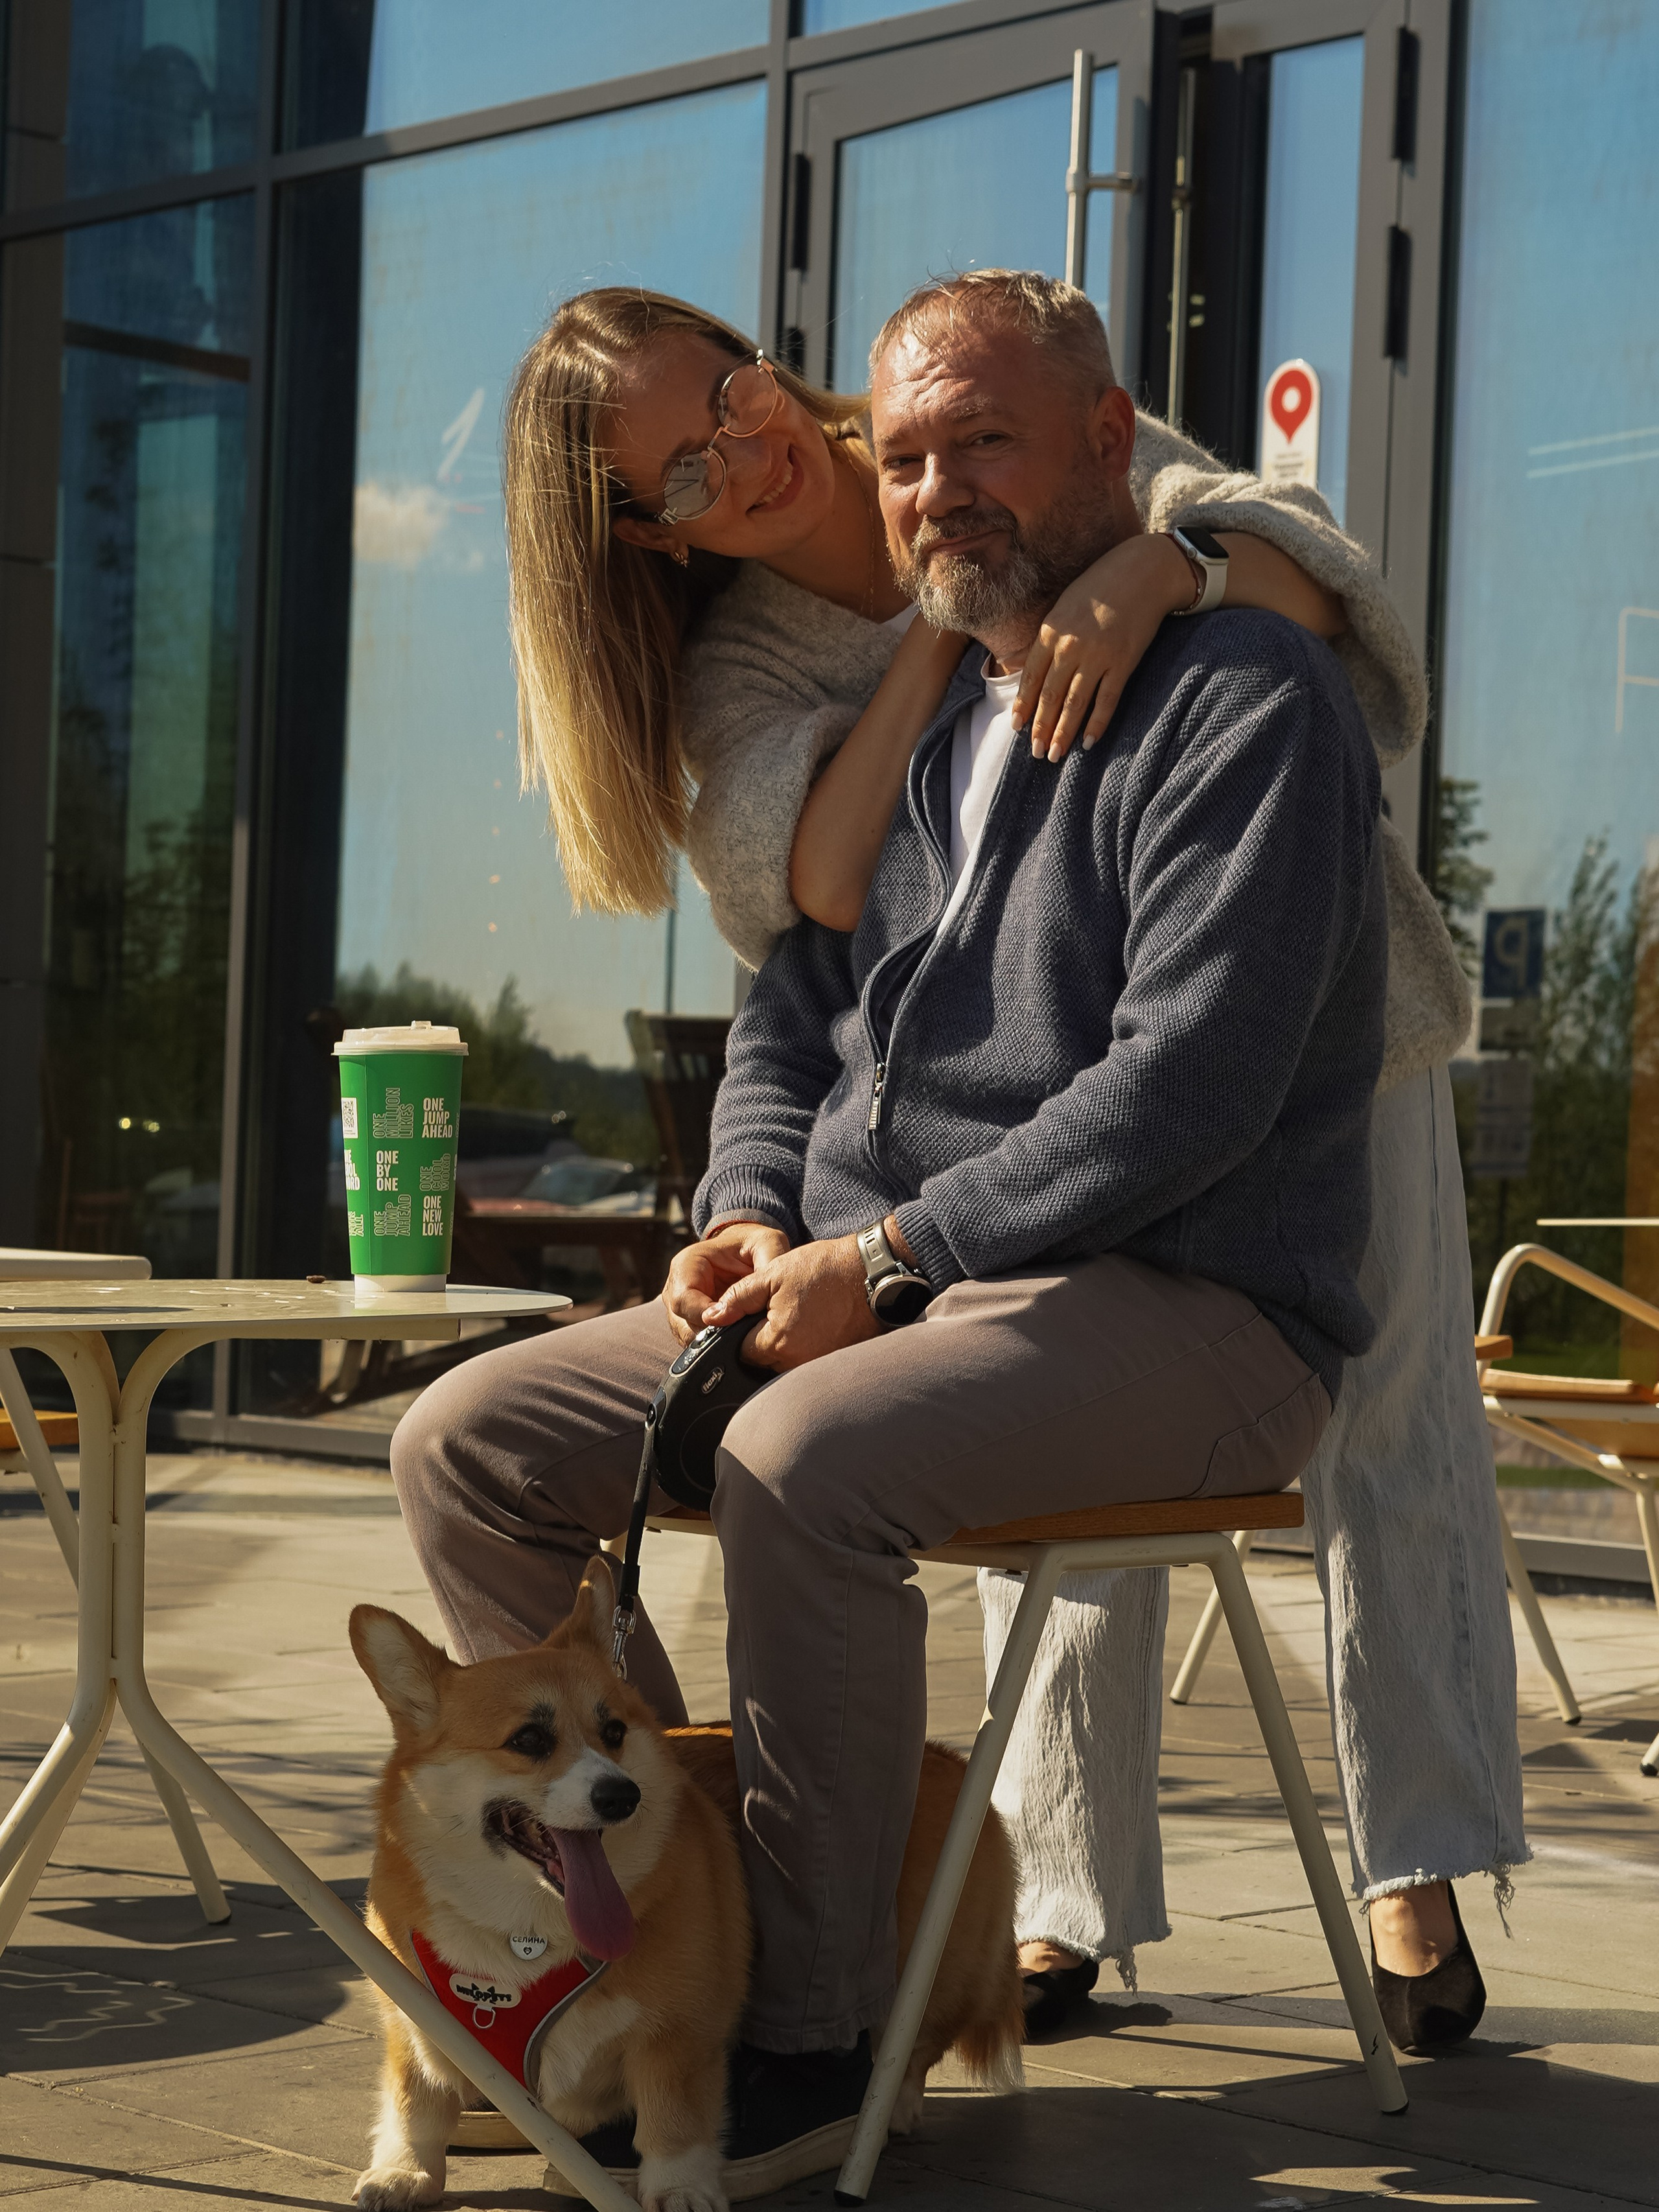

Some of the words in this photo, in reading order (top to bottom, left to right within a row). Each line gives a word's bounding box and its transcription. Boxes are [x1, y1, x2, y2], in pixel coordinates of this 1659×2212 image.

[386, 1087, 400, 1139] MILLION
[423, 1097, 445, 1111] ONE
[373, 1113, 386, 1139] ONE
[399, 1103, 414, 1139] LIKES
[423, 1111, 450, 1125] JUMP
[422, 1124, 453, 1139] AHEAD
[344, 1150, 353, 1163] NE
[376, 1150, 399, 1164] ONE
[377, 1164, 391, 1178] BY
[420, 1166, 432, 1191] ONE
[431, 1157, 443, 1191] COOL
[441, 1153, 451, 1191] WORD
[377, 1178, 399, 1191] ONE
[423, 1195, 442, 1209] ONE
[374, 1211, 386, 1237] ONE
[385, 1202, 399, 1237] JUMP
[397, 1194, 412, 1237] AHEAD
[423, 1209, 442, 1222] NEW
[356, 1214, 364, 1237] ALL
[422, 1222, 443, 1236] LOVE
